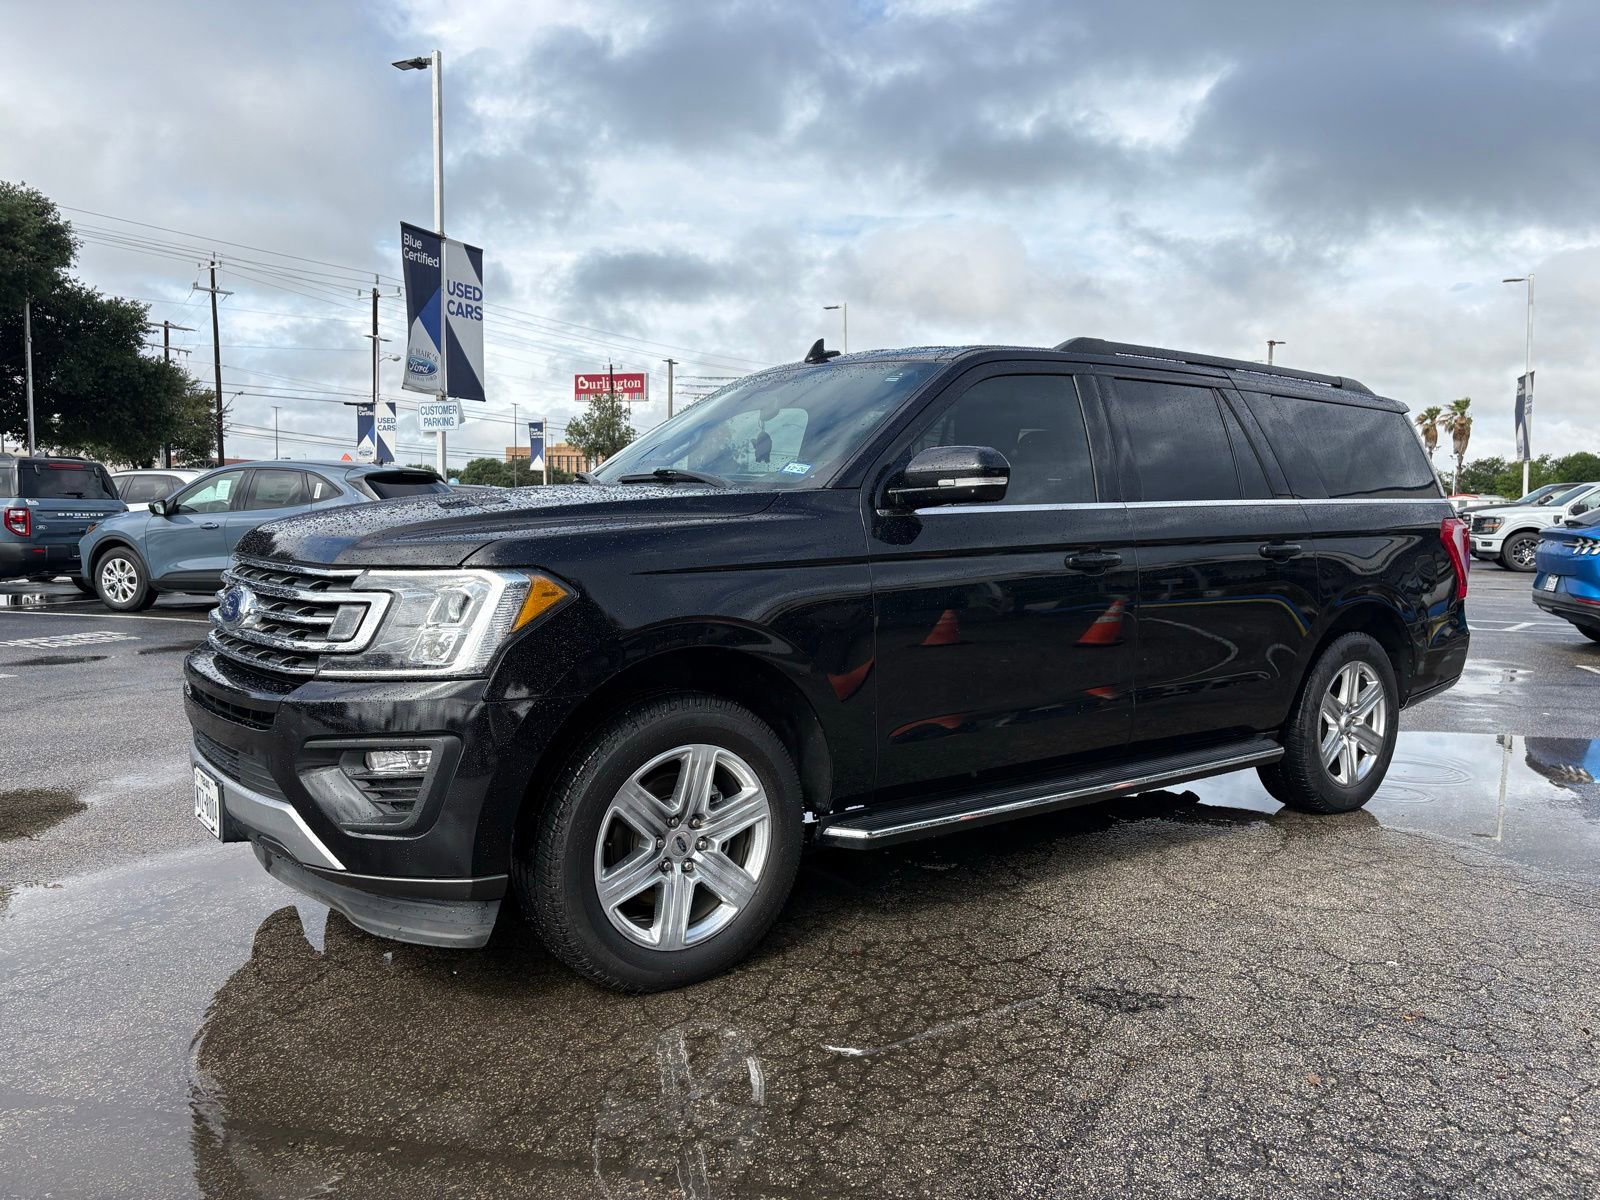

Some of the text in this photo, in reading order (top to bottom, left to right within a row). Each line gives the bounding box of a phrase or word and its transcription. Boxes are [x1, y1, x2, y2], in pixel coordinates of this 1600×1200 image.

[403, 233, 422, 249] Blue
[403, 247, 439, 268] Certified
[447, 280, 483, 302] USED
[446, 299, 483, 321] CARS
[578, 376, 641, 392] Burlington
[420, 405, 457, 416] CUSTOMER
[423, 417, 454, 427] PARKING
